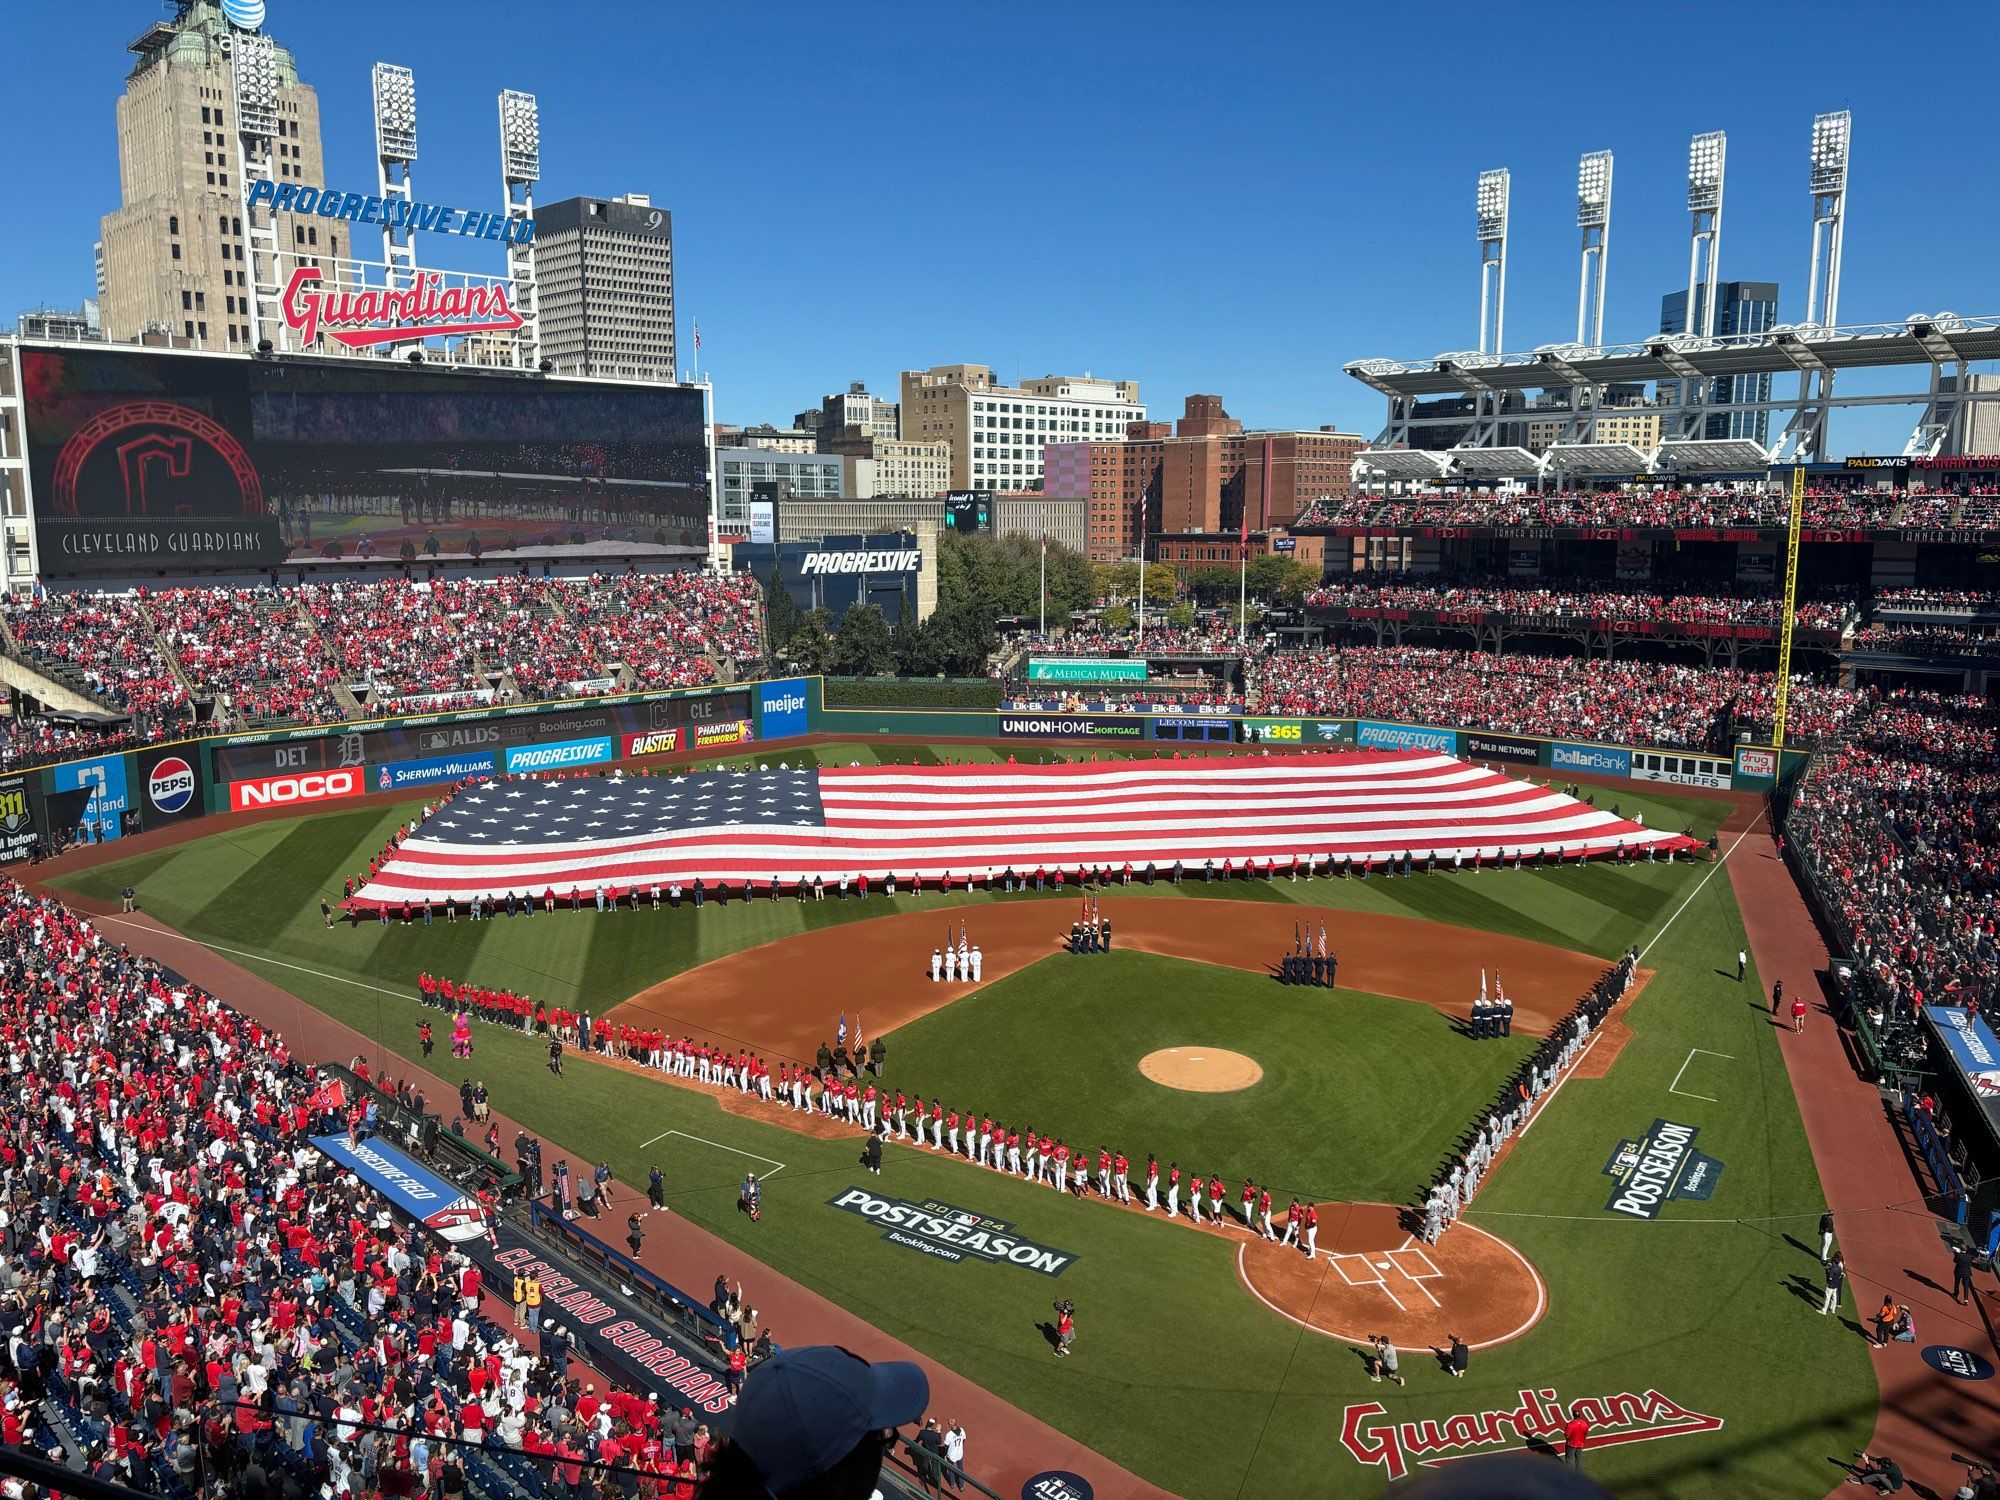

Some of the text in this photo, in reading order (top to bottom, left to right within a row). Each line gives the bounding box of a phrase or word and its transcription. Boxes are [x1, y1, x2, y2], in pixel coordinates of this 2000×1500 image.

[248, 179, 536, 243] PROGRESSIVE FIELD
[281, 267, 525, 348] Guardians
[62, 532, 261, 553] CLEVELAND GUARDIANS
[1494, 529, 1525, 538] TANNER
[1901, 531, 1985, 542] TANNER BIBEE
[800, 550, 921, 574] PROGRESSIVE
[1055, 670, 1139, 679] MEDICAL MUTUAL
[505, 706, 538, 714] PROGRESSIVE
[690, 702, 712, 719] CLE
[763, 694, 805, 714] meijer
[403, 716, 439, 725] PROGRESSIVE
[455, 711, 490, 720] PROGRESSIVE
[540, 717, 606, 733] Booking.com
[290, 728, 329, 738] PROGRESSIVE
[348, 722, 386, 731] PROGRESSIVE
[451, 726, 500, 746] ALDS
[697, 723, 739, 736] PHANTOM
[228, 734, 270, 744] PROGRESSIVE
[631, 733, 677, 756] BLASTER
[697, 732, 739, 746] FIREWORKS
[1360, 727, 1449, 748] PROGRESSIVE
[275, 746, 307, 768] DET
[510, 743, 605, 768] PROGRESSIVE
[1481, 743, 1537, 756] MLB NETWORK
[1741, 751, 1768, 766] drug
[1743, 765, 1774, 774] mart
[152, 776, 191, 794] PEPSI
[241, 772, 353, 806] NOCO
[1669, 774, 1719, 788] CLIFFS
[1613, 1123, 1693, 1218] POSTSEASON
[1683, 1161, 1708, 1192] Booking.com
[391, 1175, 438, 1200] FIELD
[924, 1202, 1005, 1231] 20 24
[834, 1190, 1067, 1272] POSTSEASON
[889, 1232, 960, 1260] Booking.com
[495, 1248, 734, 1414] CLEVELAND GUARDIANS
[1947, 1350, 1970, 1376] ALDS
[1340, 1388, 1724, 1481] Guardians
